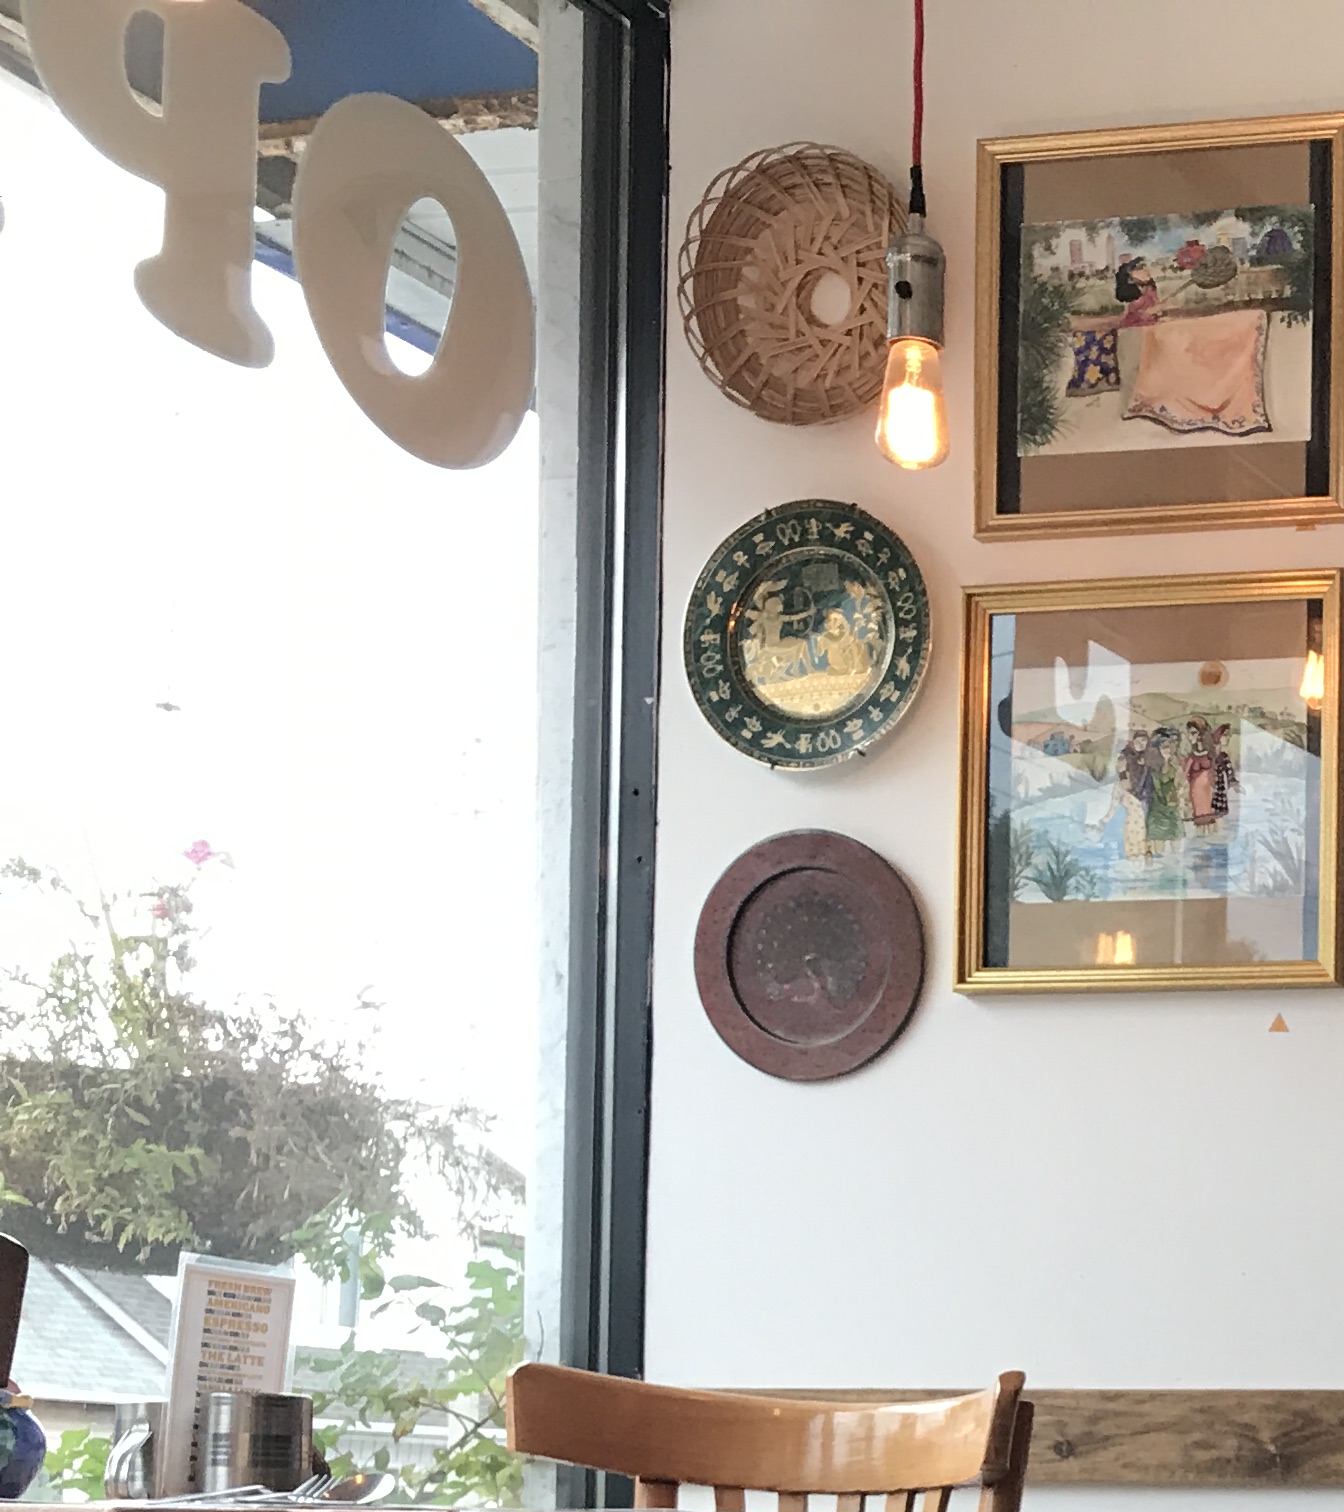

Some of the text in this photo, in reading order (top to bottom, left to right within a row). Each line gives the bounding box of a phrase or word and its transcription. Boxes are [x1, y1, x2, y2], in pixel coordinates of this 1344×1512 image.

[208, 1298, 270, 1314] AMERICANO
[204, 1316, 268, 1334] ESPRESSO
[202, 1351, 225, 1363] THE
[227, 1353, 264, 1366] LATTE
